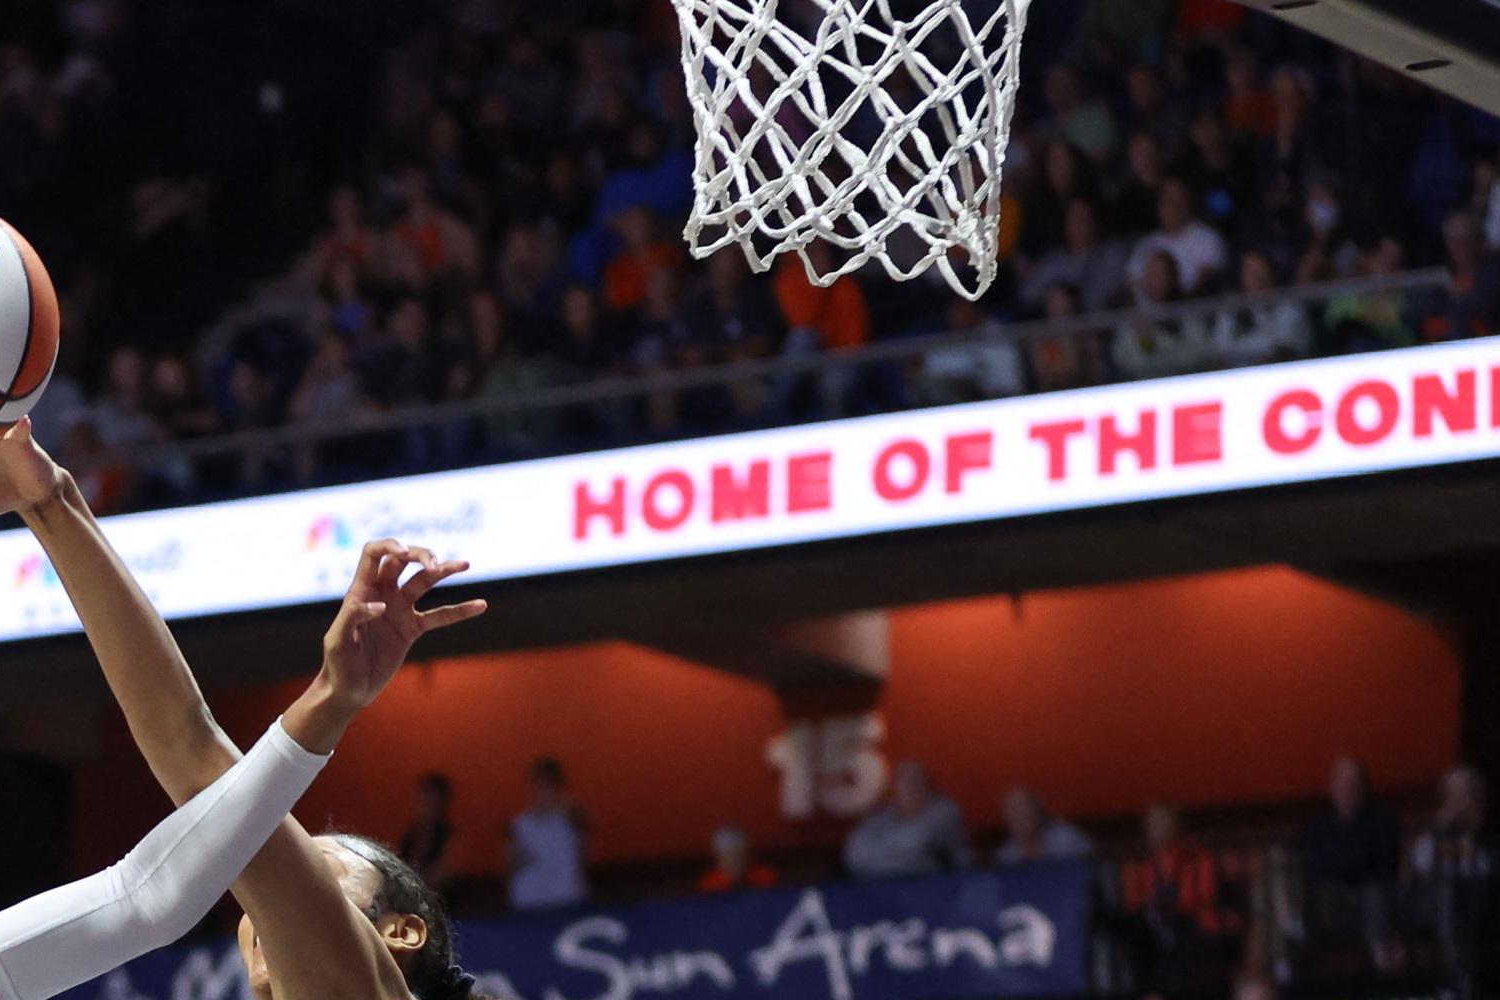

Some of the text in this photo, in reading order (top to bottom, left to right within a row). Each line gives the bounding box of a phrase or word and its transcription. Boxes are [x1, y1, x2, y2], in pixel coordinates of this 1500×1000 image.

[573, 450, 835, 542] HOME
[871, 430, 994, 505] OF
[1027, 400, 1224, 483] THE
[1260, 364, 1500, 457] CON
[764, 713, 888, 816] 15
